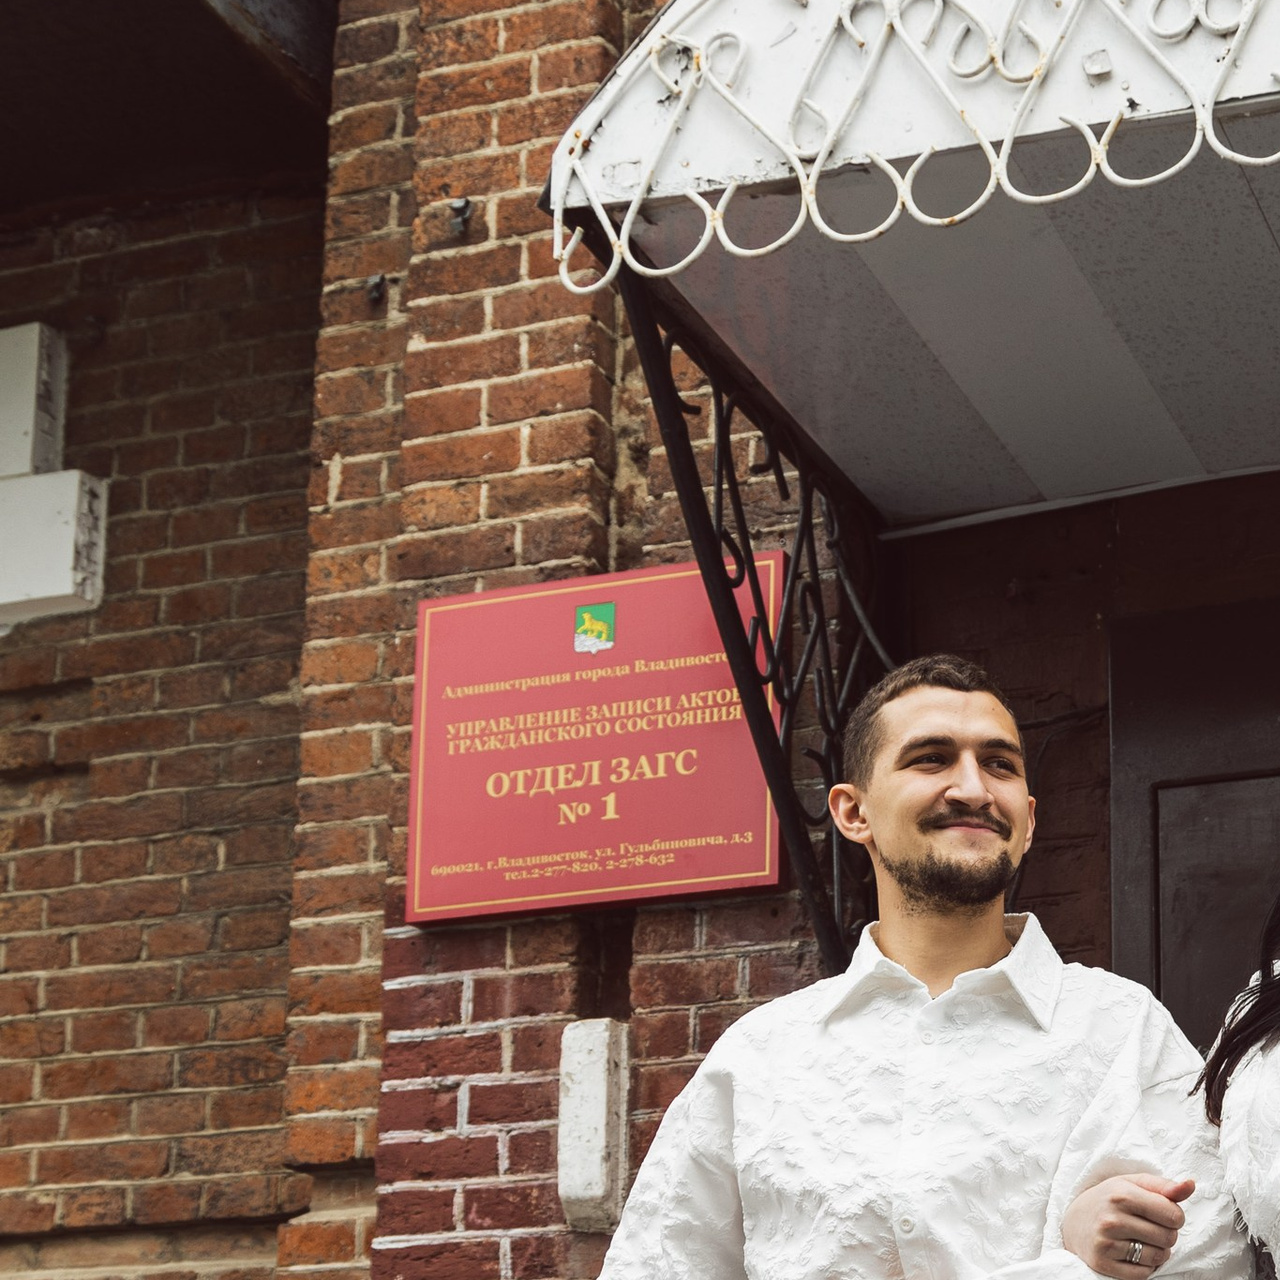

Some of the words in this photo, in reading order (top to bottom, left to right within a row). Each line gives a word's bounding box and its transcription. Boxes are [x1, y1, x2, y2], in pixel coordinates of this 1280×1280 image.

[442, 672, 571, 699] Администрация
[574, 663, 630, 682] города
[446, 706, 582, 739] УПРАВЛЕНИЕ
[585, 695, 671, 721] ЗАПИСИ
[447, 720, 611, 756] ГРАЖДАНСКОГО
[614, 703, 742, 734] СОСТОЯНИЯ
[485, 760, 602, 798] ОТДЕЛ
[609, 749, 698, 784] ЗАГС
[600, 792, 620, 820] 1
[595, 845, 616, 860] ул.
